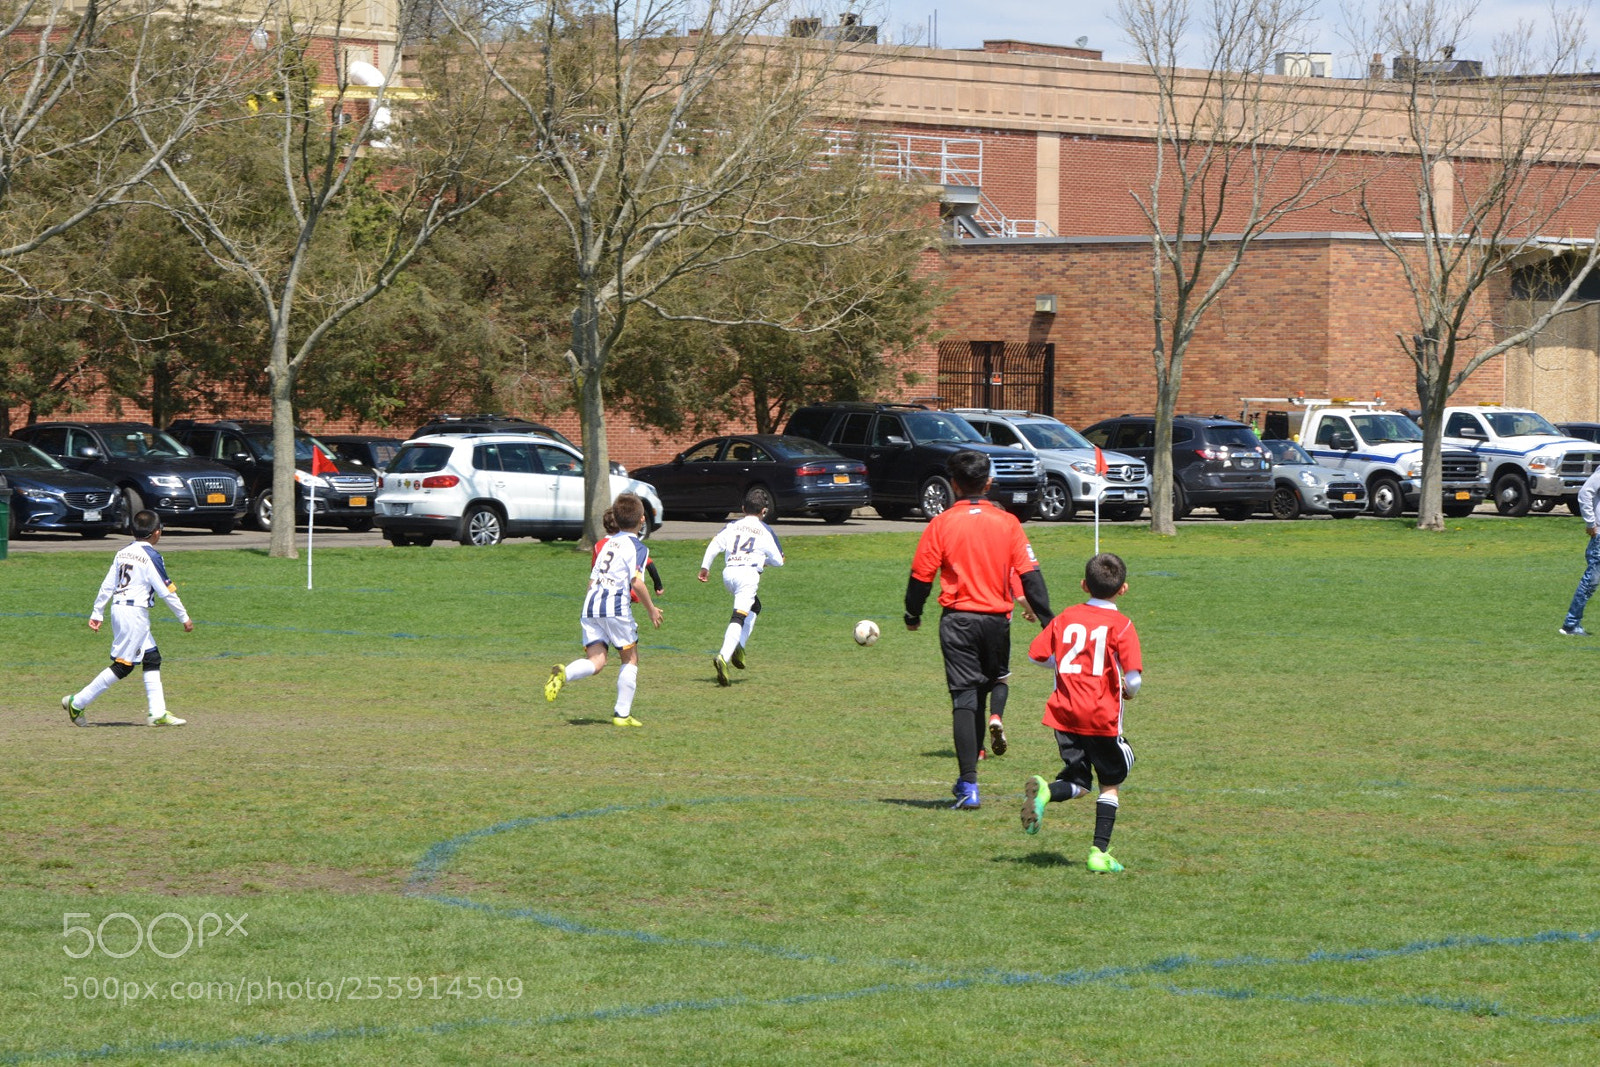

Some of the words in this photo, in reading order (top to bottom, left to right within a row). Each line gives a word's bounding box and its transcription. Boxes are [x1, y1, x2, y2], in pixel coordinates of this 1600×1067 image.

[731, 534, 756, 554] 14
[599, 551, 615, 574] 3
[117, 563, 134, 589] 15
[1059, 623, 1109, 677] 21
